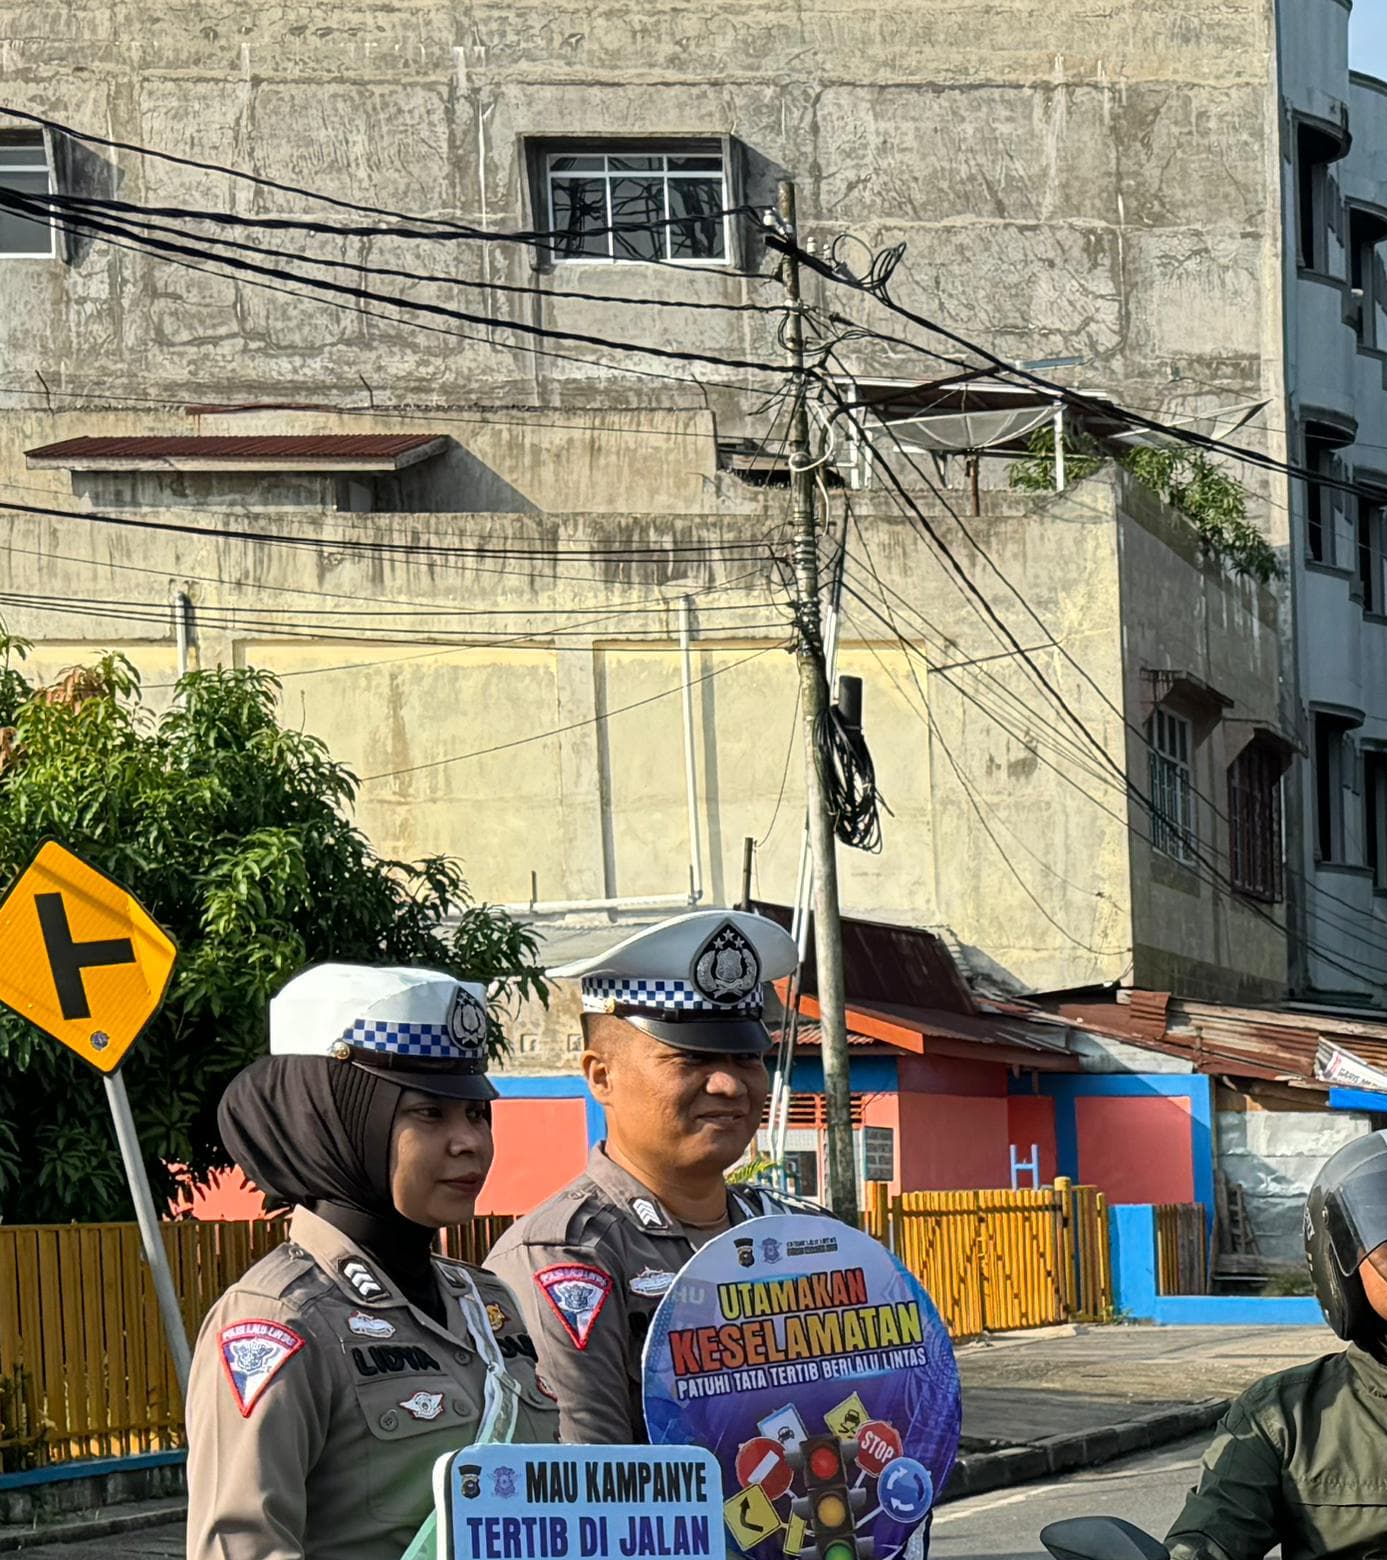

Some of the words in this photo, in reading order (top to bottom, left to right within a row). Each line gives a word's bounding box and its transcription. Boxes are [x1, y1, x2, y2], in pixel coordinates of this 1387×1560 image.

[717, 1267, 868, 1321] UTAMAKAN
[668, 1301, 924, 1376] KESELAMATAN
[675, 1373, 731, 1401] PATUHI
[733, 1369, 768, 1394] TATA
[769, 1363, 819, 1388] TERTIB
[860, 1430, 895, 1464] STOP
[525, 1461, 579, 1503] MAU
[586, 1461, 708, 1503] KAMPANYE
[466, 1516, 568, 1559] TERTIB
[578, 1516, 608, 1558] DI
[619, 1515, 710, 1558] JALAN
